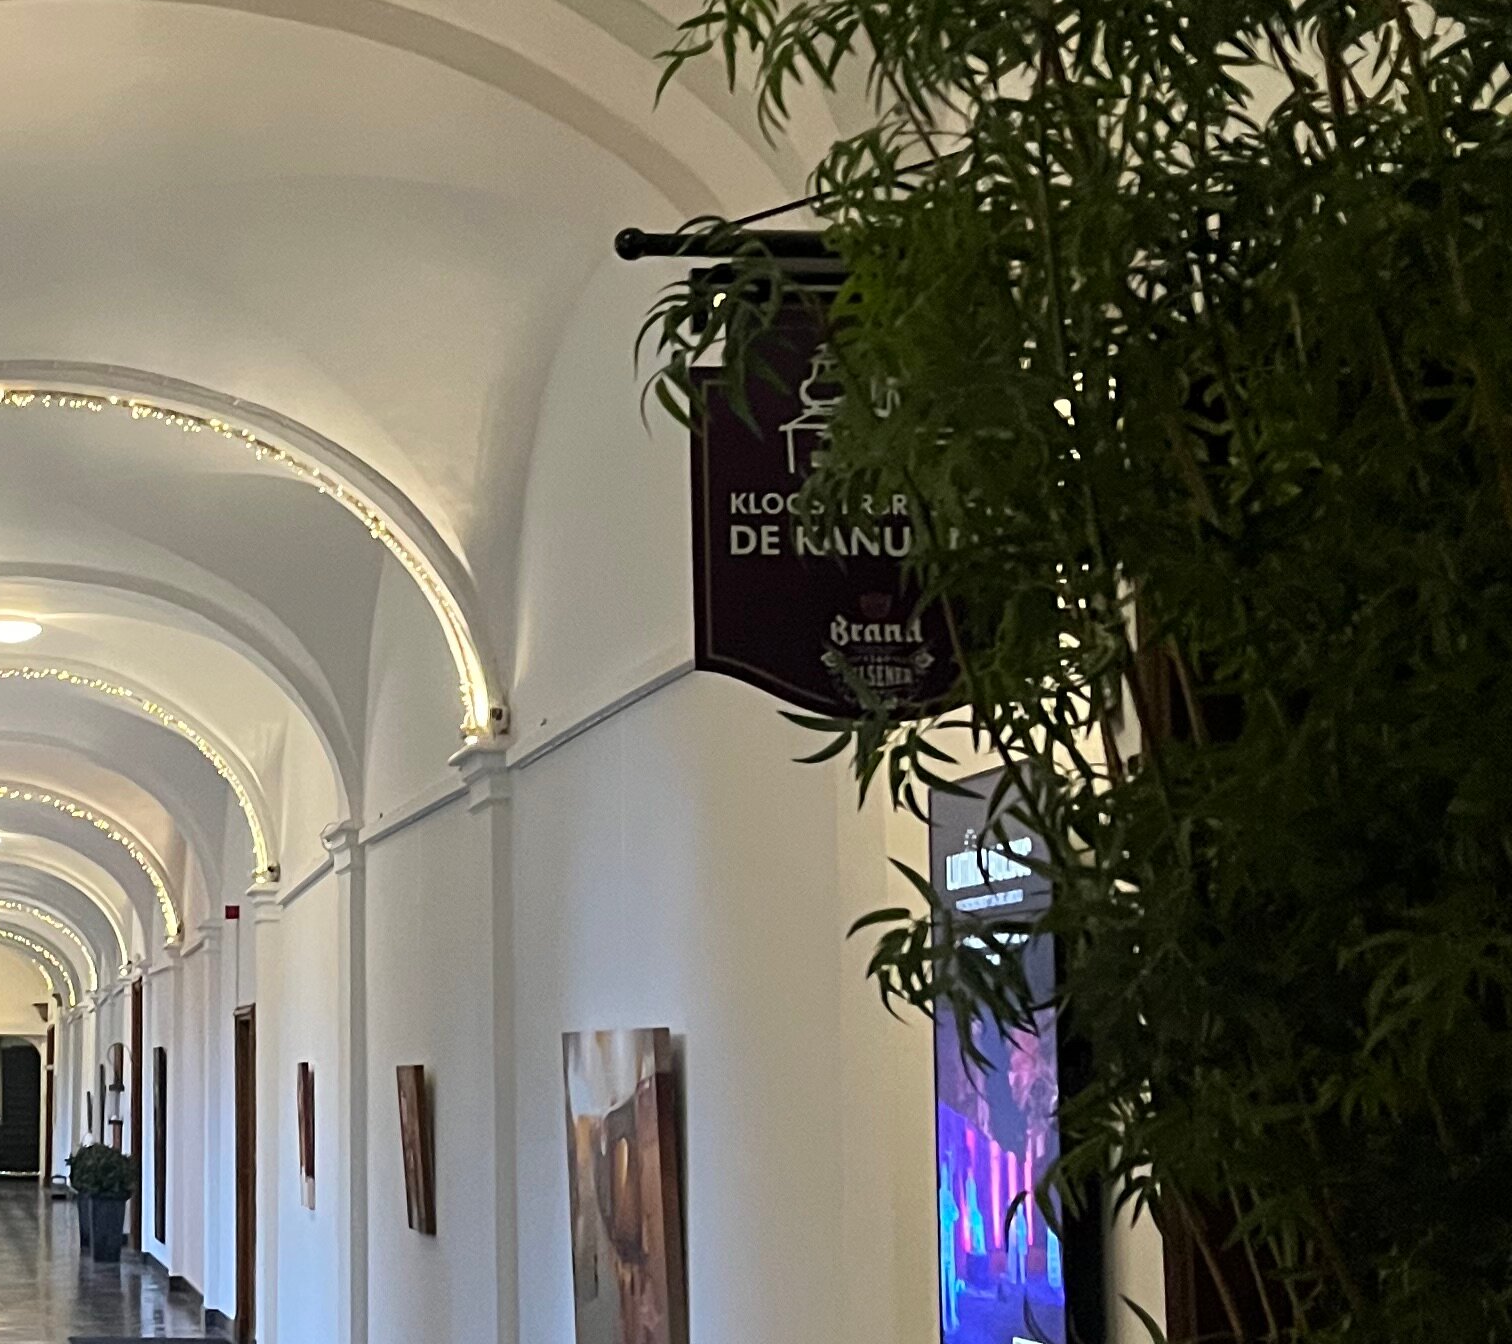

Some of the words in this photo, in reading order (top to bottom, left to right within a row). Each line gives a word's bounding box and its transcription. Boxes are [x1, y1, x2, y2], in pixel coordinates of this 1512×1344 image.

[730, 525, 780, 555] DE
[796, 525, 911, 557] KANU
[830, 614, 924, 646] Brand
